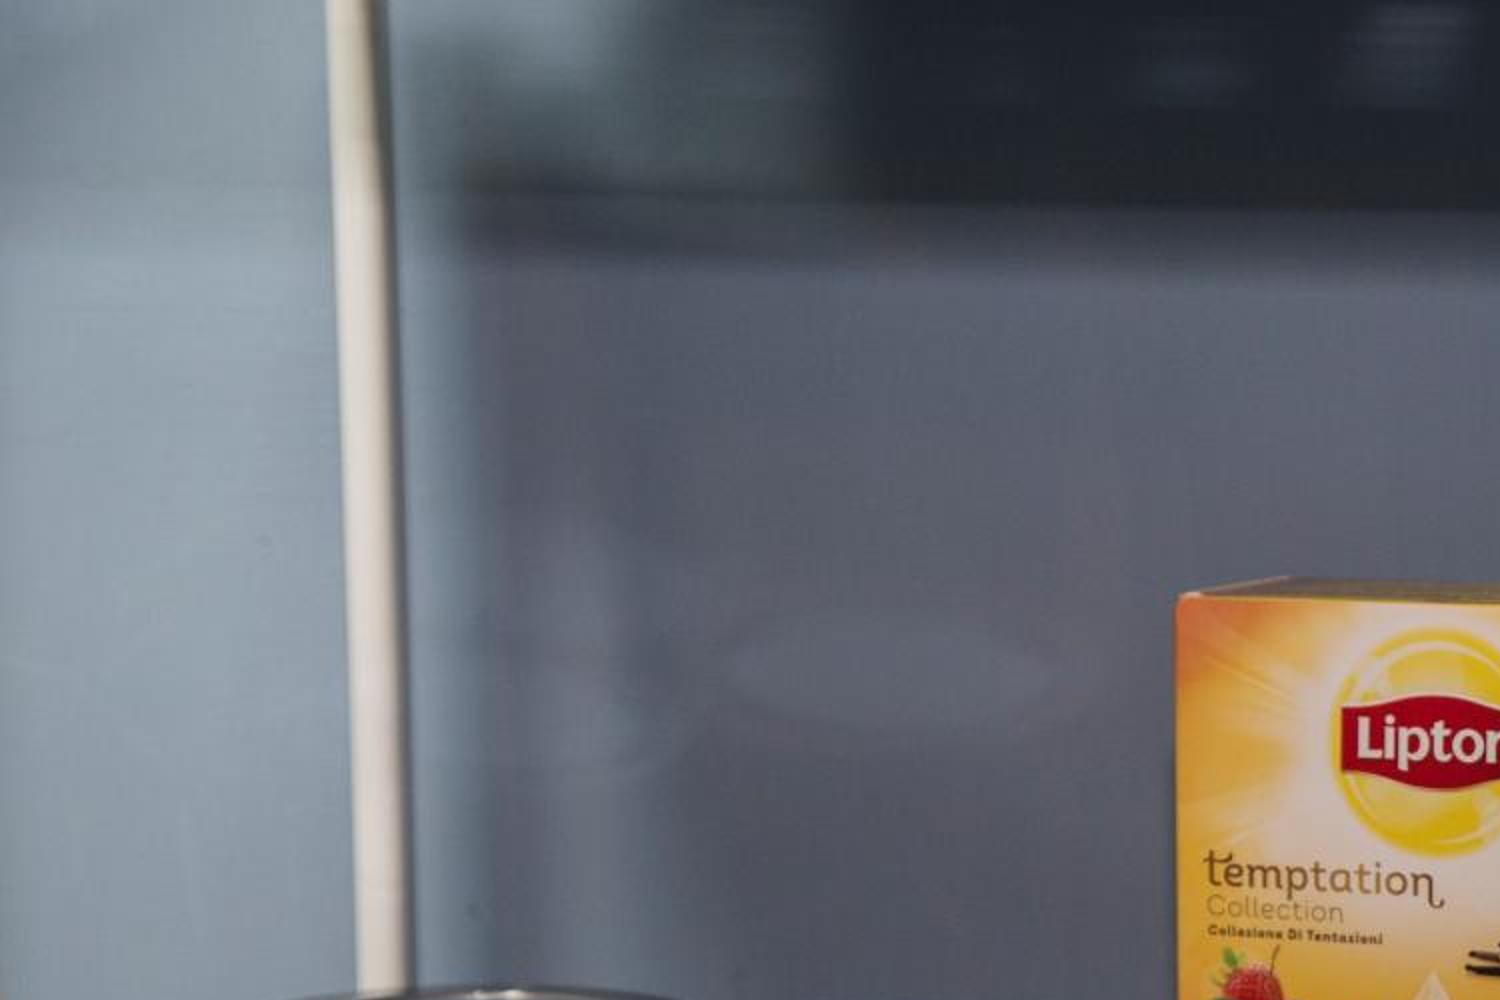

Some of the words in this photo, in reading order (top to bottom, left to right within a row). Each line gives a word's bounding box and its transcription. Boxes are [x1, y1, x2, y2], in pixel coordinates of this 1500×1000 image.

[1203, 849, 1446, 909] temptation
[1205, 893, 1345, 924] Collection
[1288, 928, 1302, 941] Di
